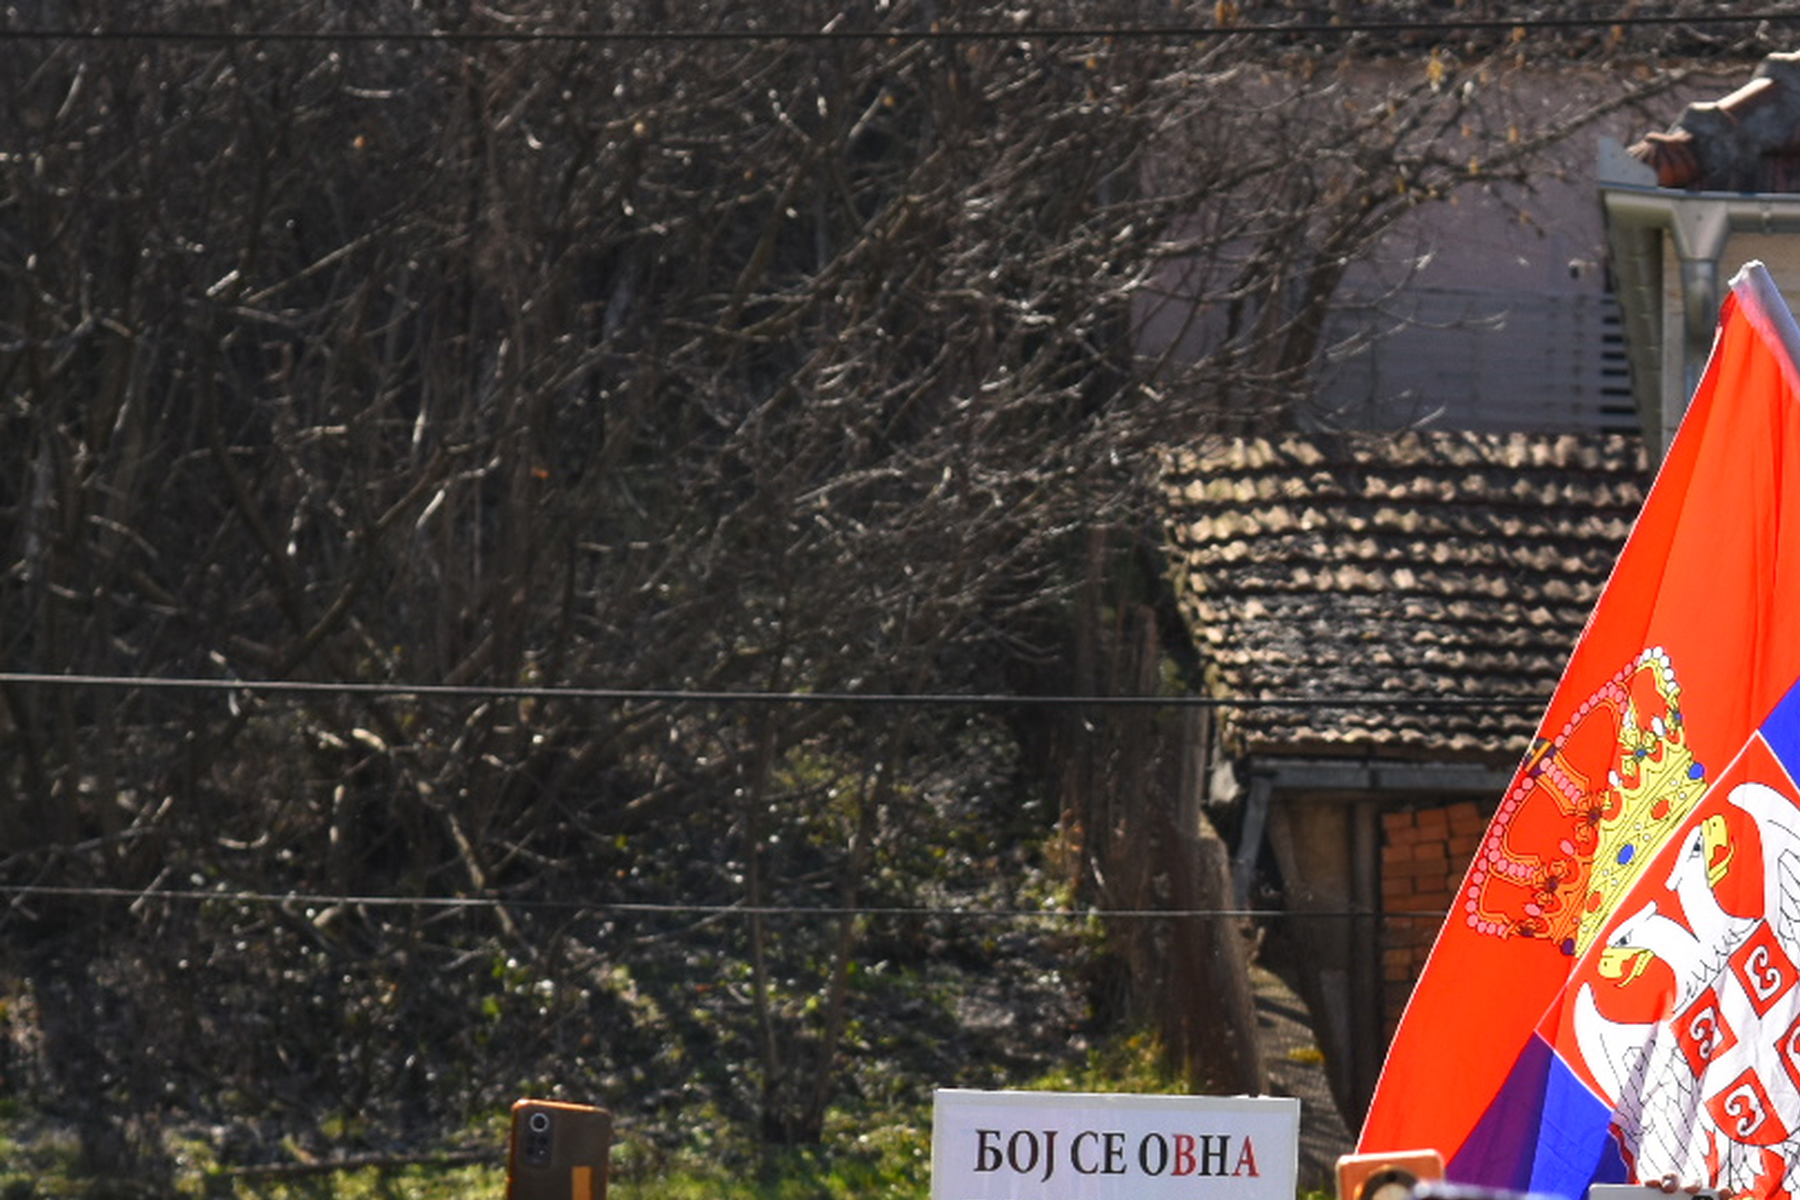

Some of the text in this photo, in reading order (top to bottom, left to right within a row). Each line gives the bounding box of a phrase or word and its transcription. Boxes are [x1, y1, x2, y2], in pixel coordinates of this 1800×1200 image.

[973, 1129, 1261, 1183] БОЈ СЕ ОВНА
